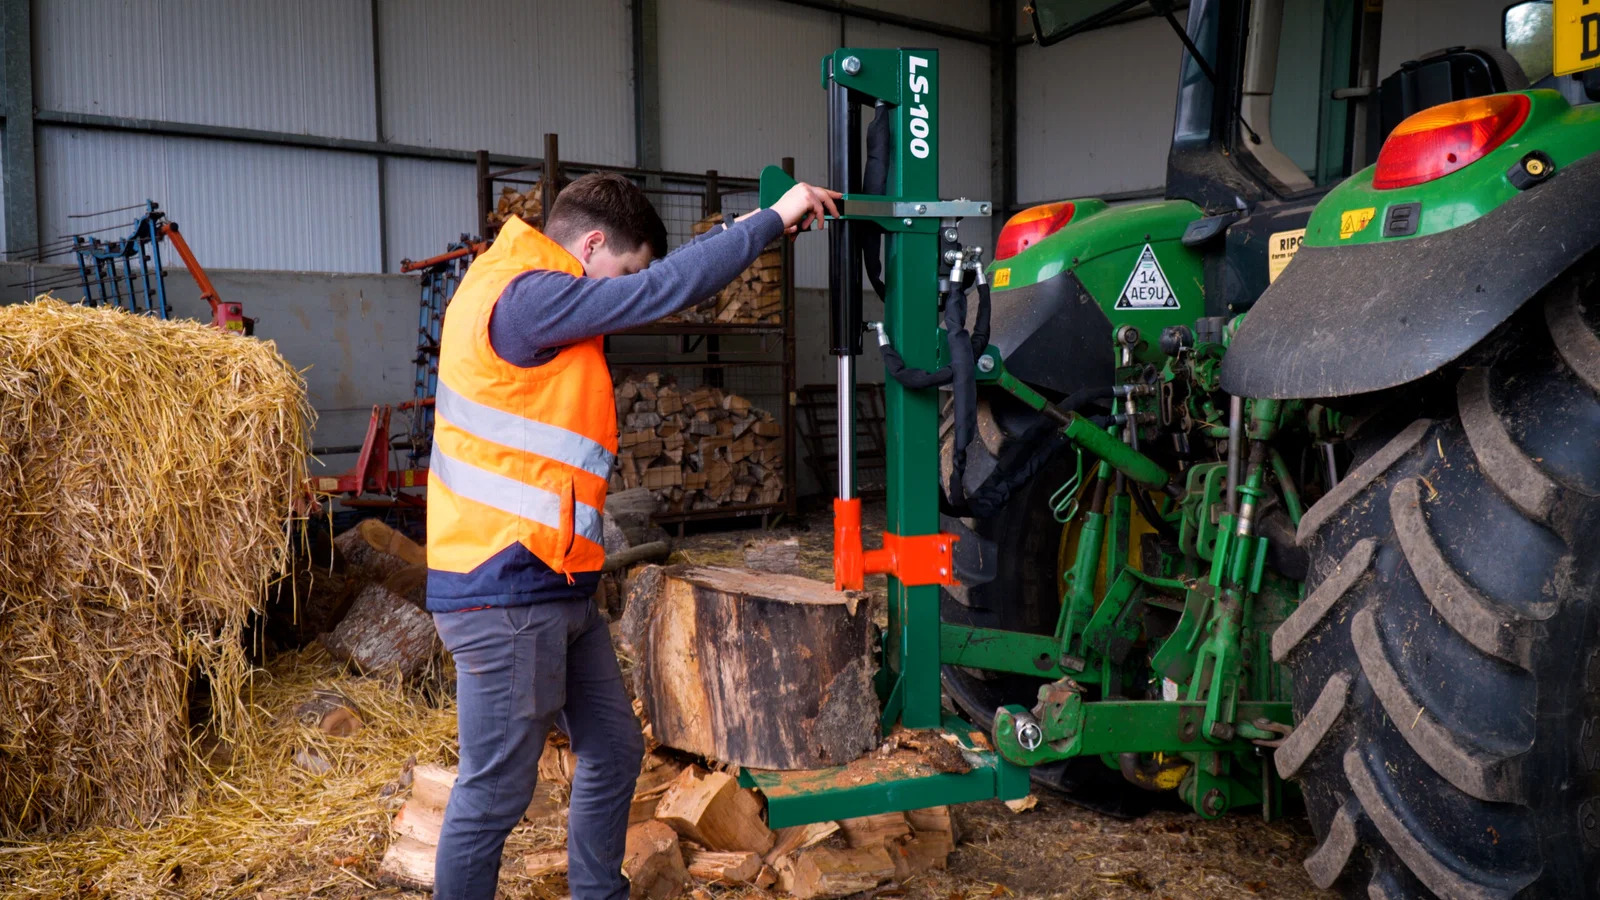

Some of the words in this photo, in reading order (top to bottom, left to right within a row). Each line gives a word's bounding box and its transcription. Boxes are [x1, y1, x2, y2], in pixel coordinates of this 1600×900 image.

[909, 55, 930, 159] LS-100
[1140, 270, 1157, 284] 14
[1131, 286, 1164, 300] AE9U
